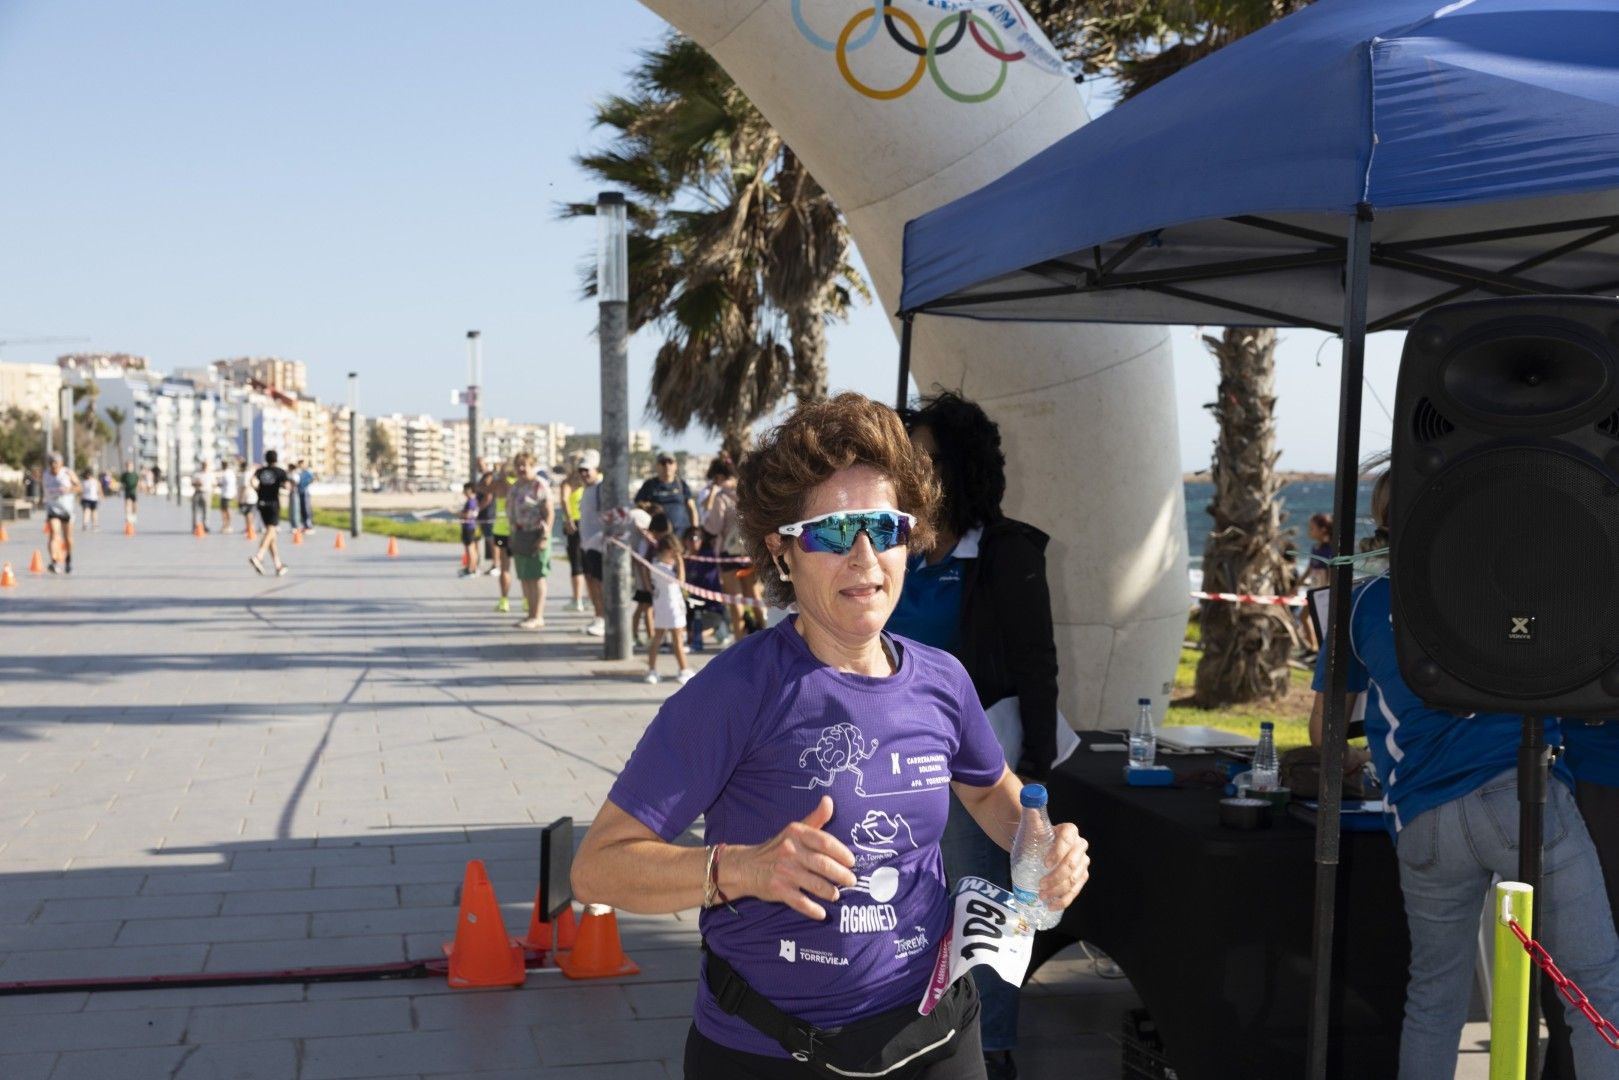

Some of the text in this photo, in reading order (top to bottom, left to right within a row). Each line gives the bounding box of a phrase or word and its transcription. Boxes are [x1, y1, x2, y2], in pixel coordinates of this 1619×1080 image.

[890, 752, 901, 775] X
[911, 779, 922, 787] AFA
[840, 904, 898, 933] AGAMED
[961, 899, 1006, 961] 109
[800, 952, 849, 965] TORREVIEJA
